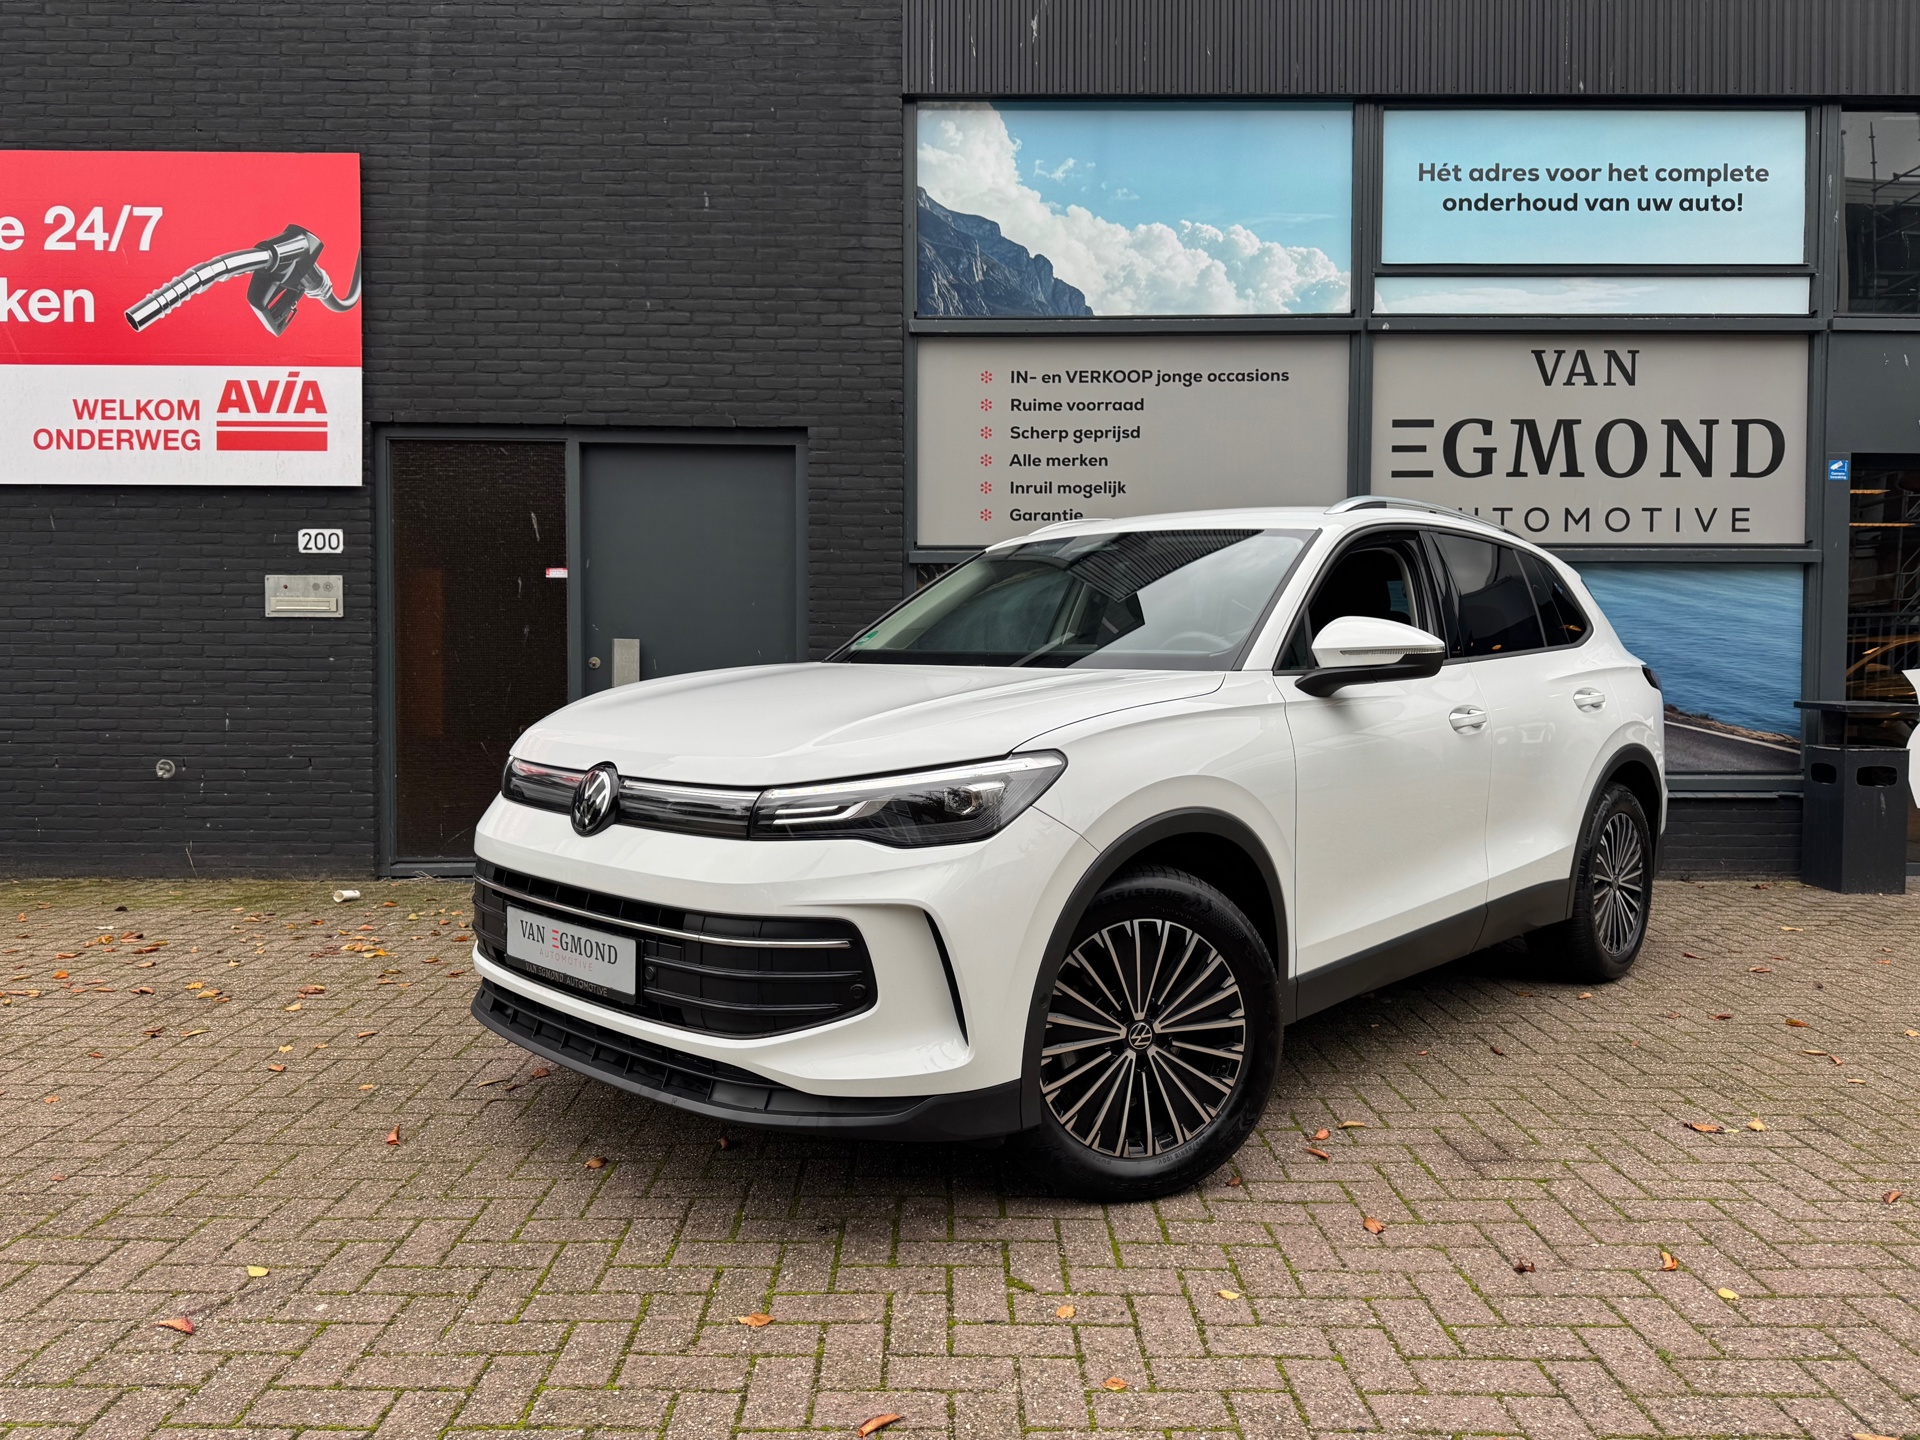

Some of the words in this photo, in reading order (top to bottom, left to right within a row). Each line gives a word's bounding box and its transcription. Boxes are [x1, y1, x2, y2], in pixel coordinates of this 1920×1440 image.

[1418, 162, 1462, 182] Hét
[1468, 162, 1540, 182] adres
[1545, 167, 1603, 182] voor
[1608, 162, 1649, 182] het
[1655, 163, 1769, 187] complete
[1442, 192, 1578, 212] onderhoud
[1584, 197, 1630, 212] van
[1637, 197, 1674, 212] uw
[1678, 193, 1743, 212] auto!
[43, 205, 163, 252] 24/7
[1010, 370, 1037, 384] IN-
[1041, 373, 1062, 384] en
[1065, 369, 1153, 384] VERKOOP
[1154, 369, 1203, 388] jonge
[1207, 368, 1290, 383] occasions
[1530, 349, 1640, 387] VAN
[72, 398, 201, 422] WELKOM
[1010, 398, 1063, 412] Ruime
[1066, 397, 1145, 412] voorraad
[33, 427, 201, 452] ONDERWEG
[1010, 425, 1069, 443] Scherp
[1073, 425, 1141, 444] geprijsd
[1008, 453, 1042, 467] Alle
[1046, 453, 1109, 467] merken
[1391, 418, 1786, 479] EGMOND
[1010, 480, 1053, 495] Inruil
[1057, 480, 1127, 499] mogelijk
[1009, 508, 1084, 522] Garantie
[1458, 506, 1751, 533] TOMOTIVE
[302, 532, 340, 551] 200
[520, 919, 546, 945] VAN
[552, 929, 618, 965] EGMOND
[539, 948, 593, 972] AUTOMOTIVE
[526, 962, 537, 974] VAN
[566, 976, 608, 997] AUTOMOTIVE
